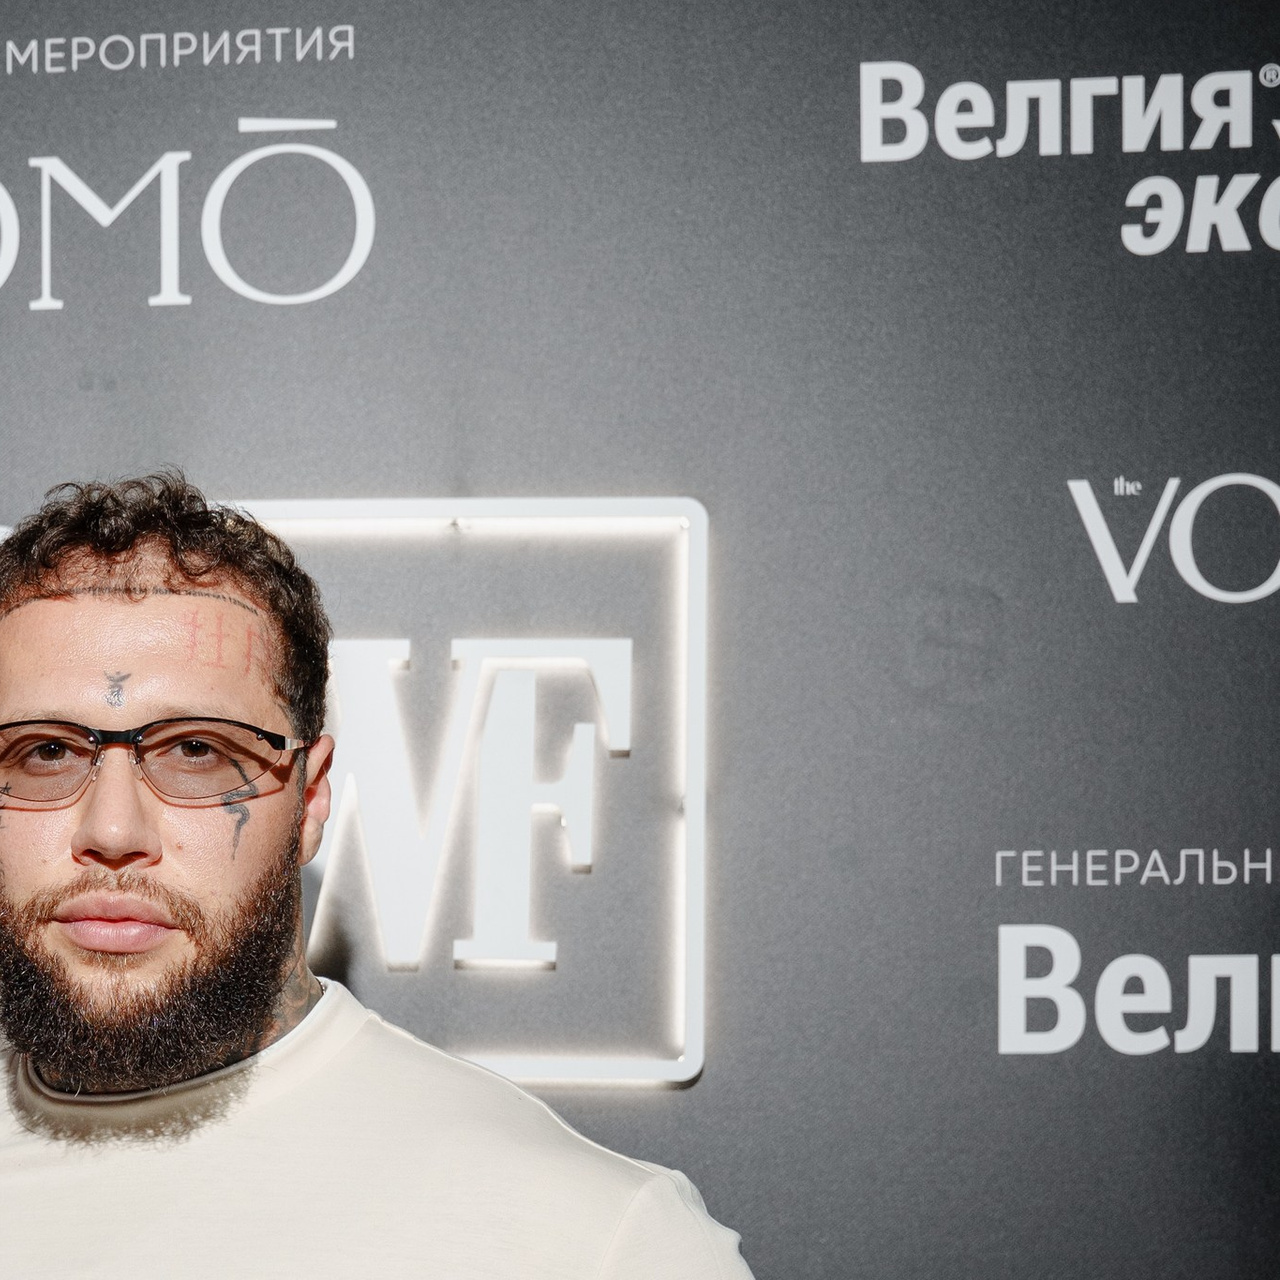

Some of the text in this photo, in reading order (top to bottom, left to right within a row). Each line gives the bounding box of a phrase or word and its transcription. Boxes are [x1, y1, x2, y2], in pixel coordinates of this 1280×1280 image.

[6, 24, 355, 75] МЕРОПРИЯТИЯ
[994, 848, 1272, 887] ГЕНЕРАЛЬН
[997, 923, 1280, 1056] Вел
